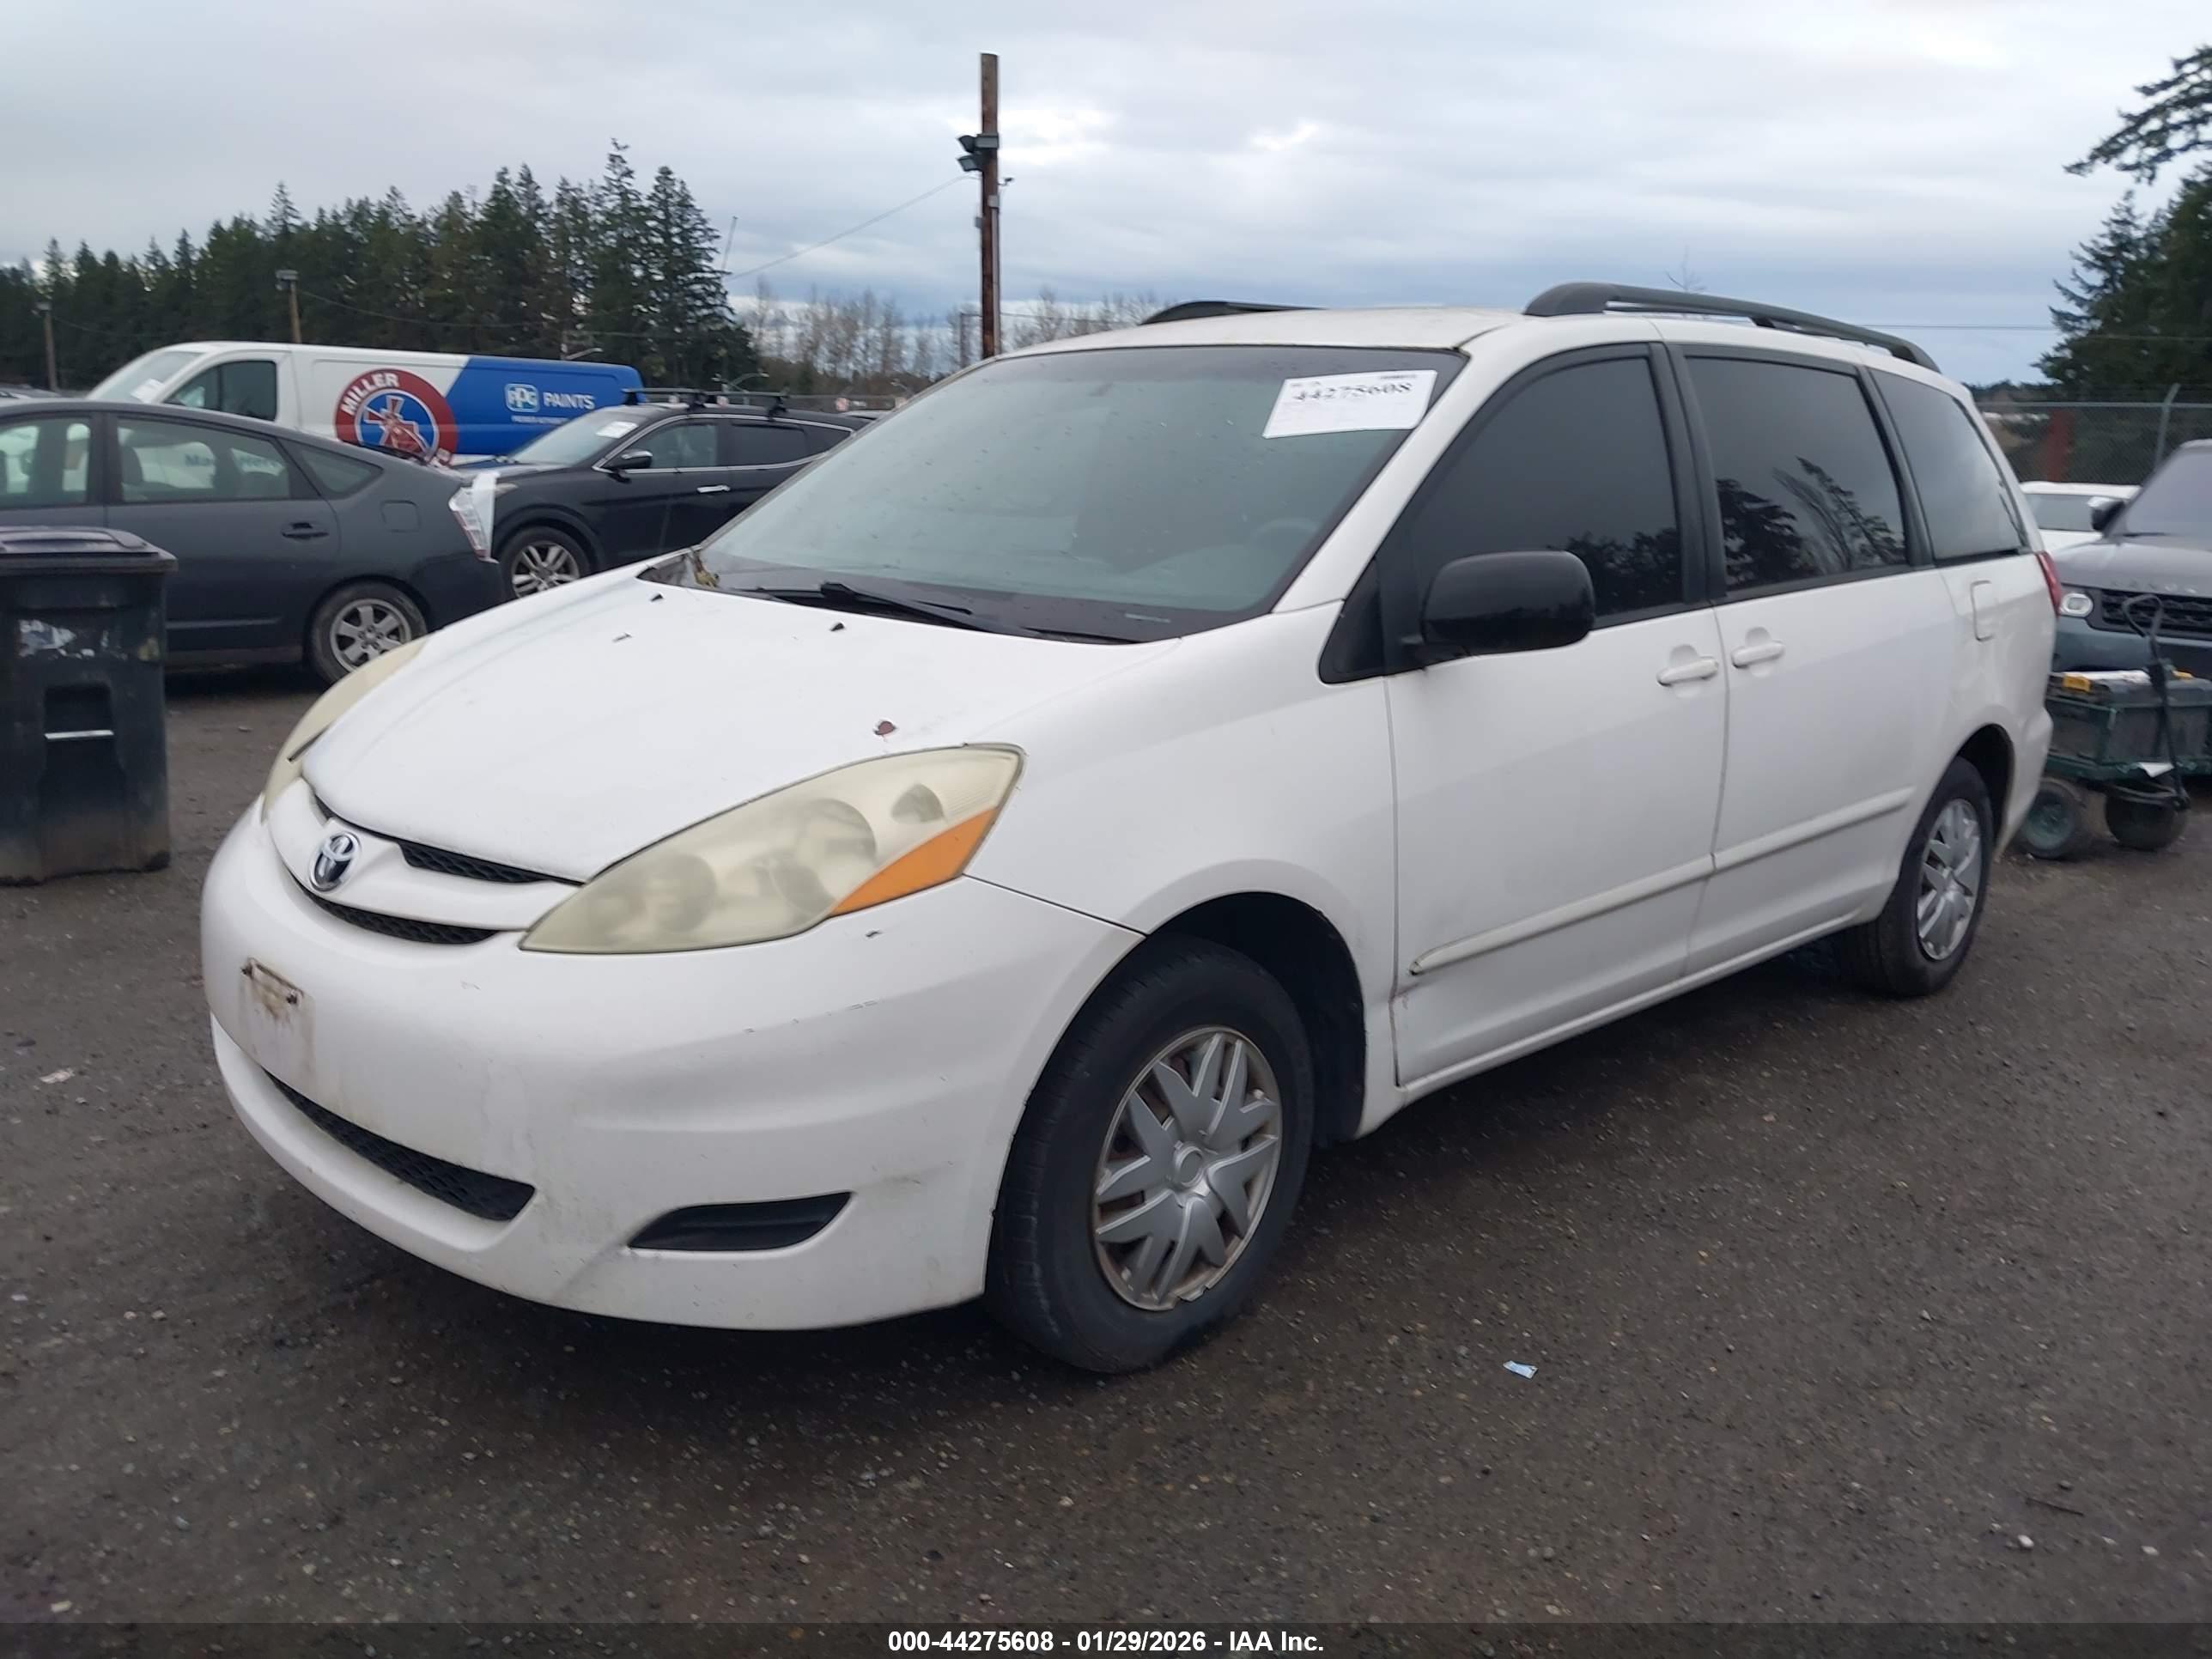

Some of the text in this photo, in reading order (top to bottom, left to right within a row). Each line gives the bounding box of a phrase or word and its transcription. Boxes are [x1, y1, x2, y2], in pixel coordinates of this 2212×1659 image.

[340, 371, 400, 416] MILLER
[507, 386, 595, 410] PPG PAINTS
